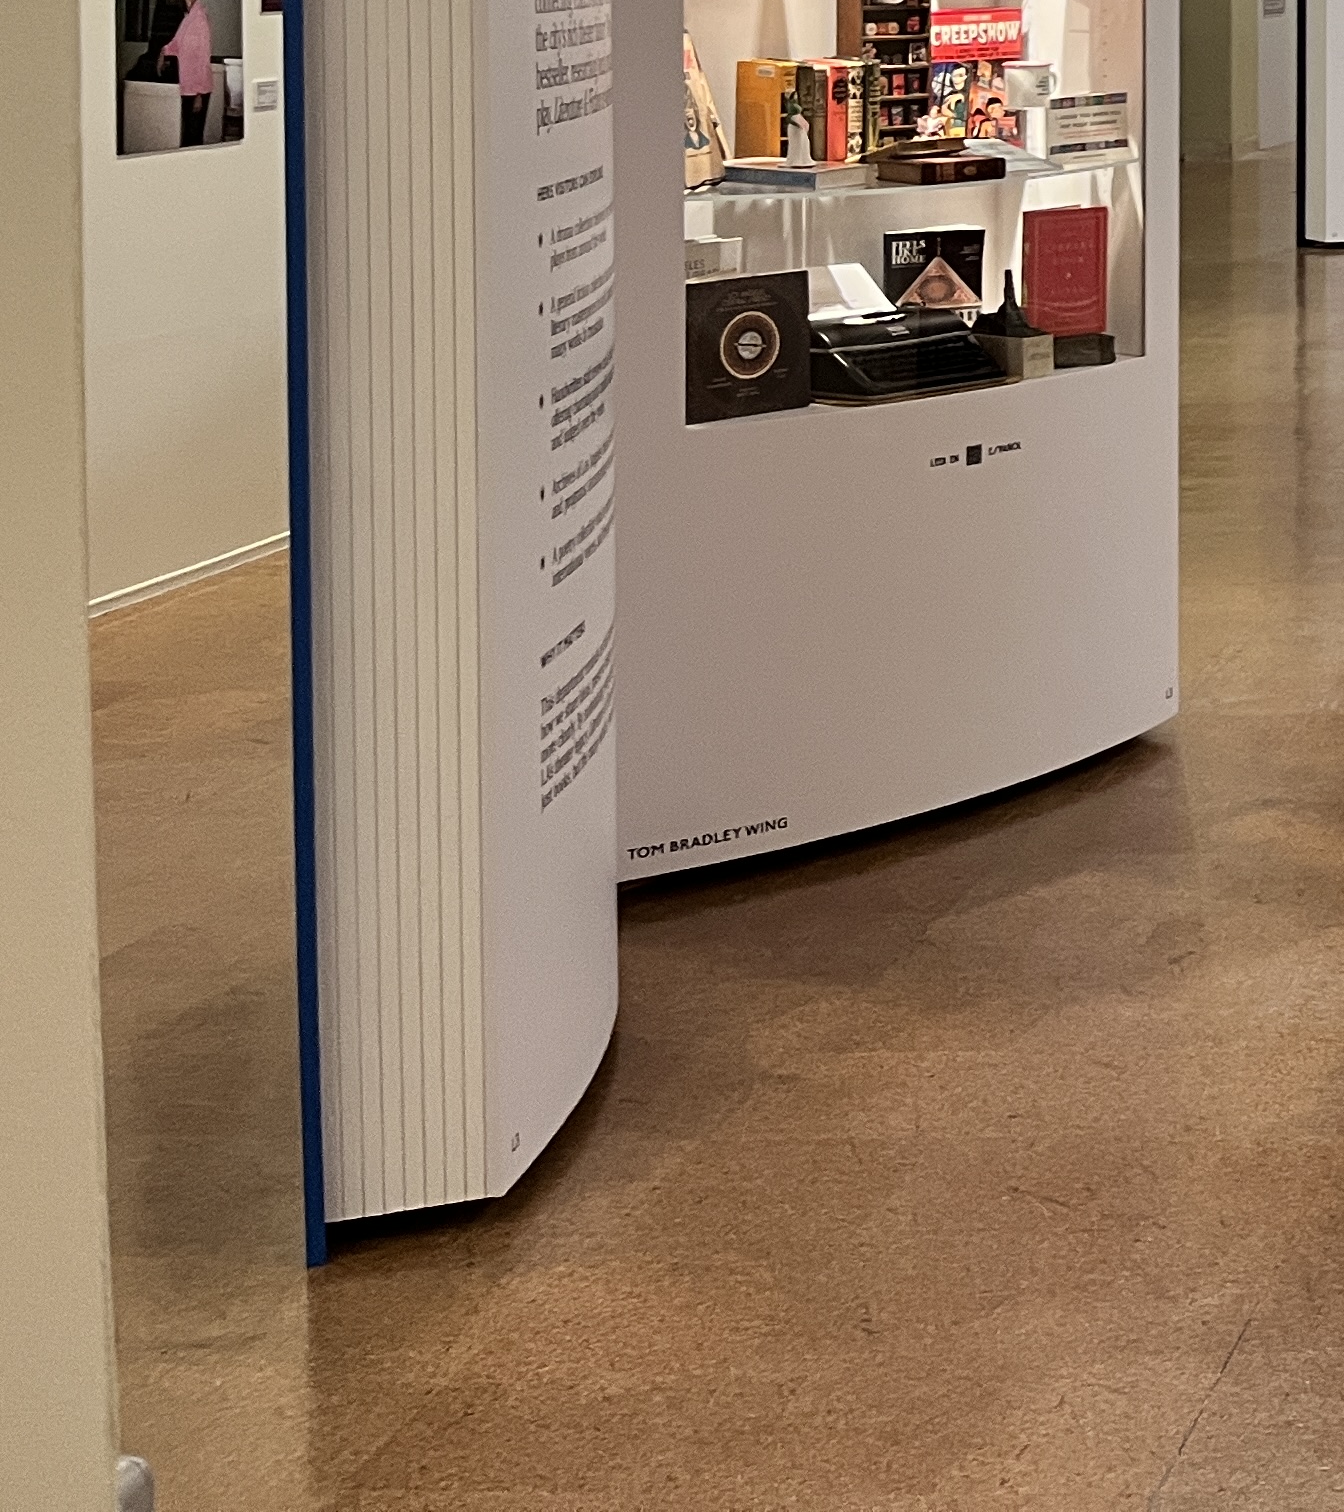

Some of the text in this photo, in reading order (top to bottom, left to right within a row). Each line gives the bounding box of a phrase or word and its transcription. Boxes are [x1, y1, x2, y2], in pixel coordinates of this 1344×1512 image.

[930, 20, 1021, 48] CREEPSHOW
[626, 816, 788, 860] TOM BRADLEY WING
